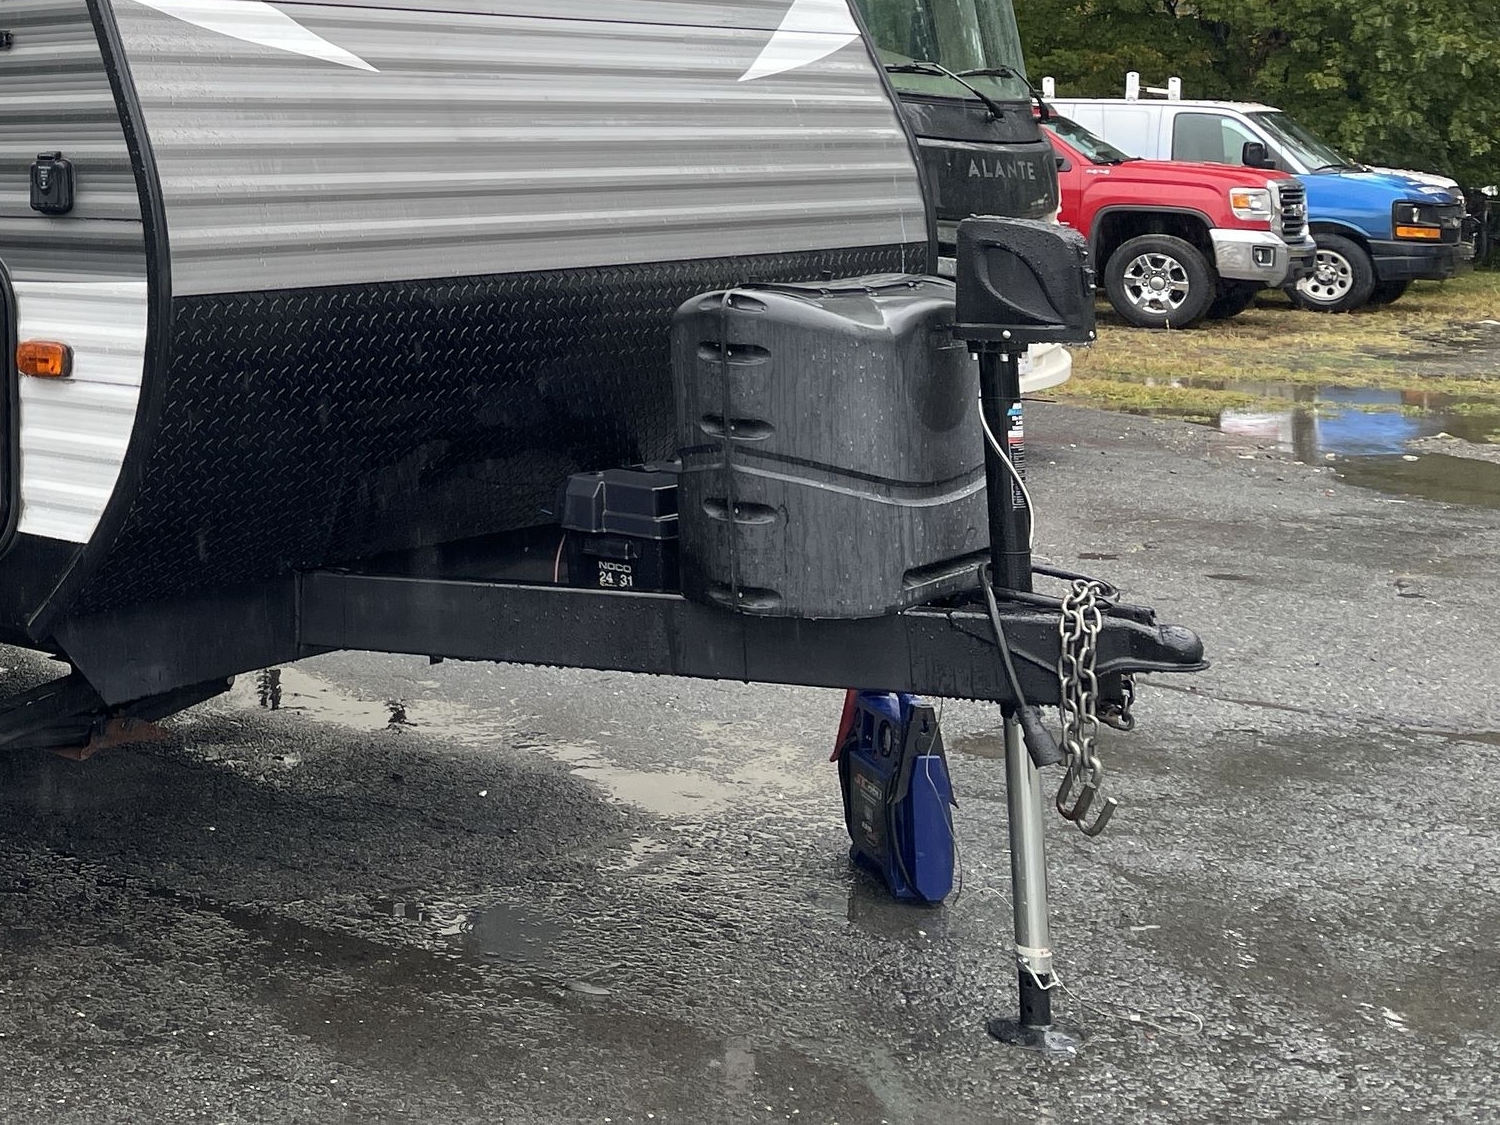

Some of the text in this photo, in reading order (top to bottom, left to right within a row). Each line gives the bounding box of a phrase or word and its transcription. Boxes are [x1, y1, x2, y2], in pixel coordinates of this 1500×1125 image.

[968, 158, 1036, 180] ALANTE
[598, 561, 632, 573] NOCO
[620, 574, 633, 587] 31
